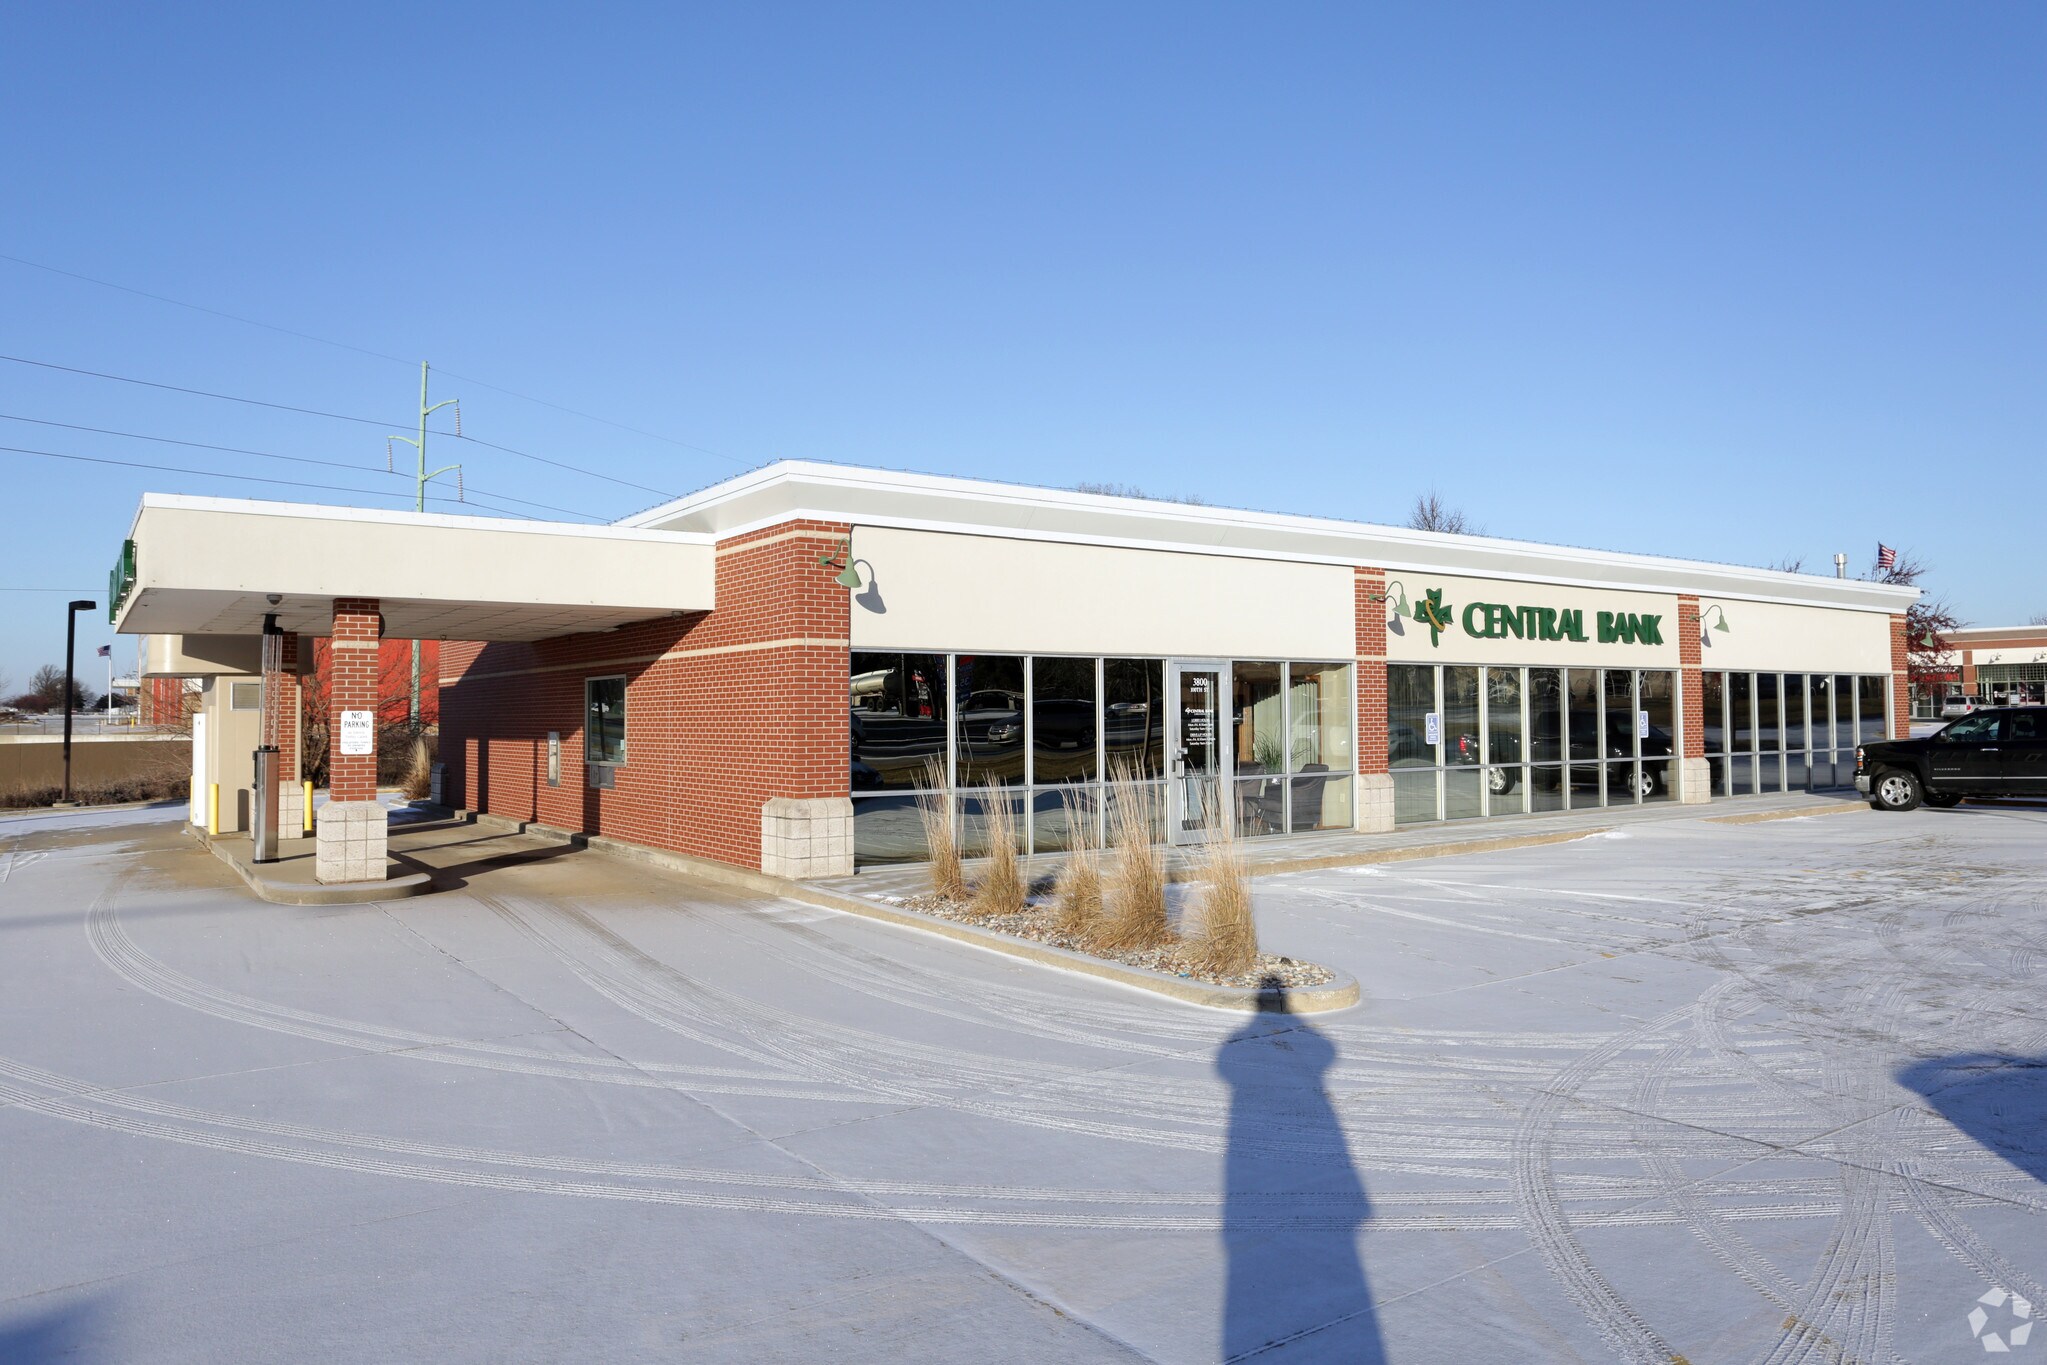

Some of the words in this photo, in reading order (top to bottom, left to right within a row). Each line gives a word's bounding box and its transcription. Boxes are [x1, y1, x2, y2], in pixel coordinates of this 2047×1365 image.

[1462, 602, 1589, 642] CENTRAL
[1597, 611, 1664, 645] BANK
[1193, 677, 1208, 686] 3800
[351, 712, 363, 720] NO
